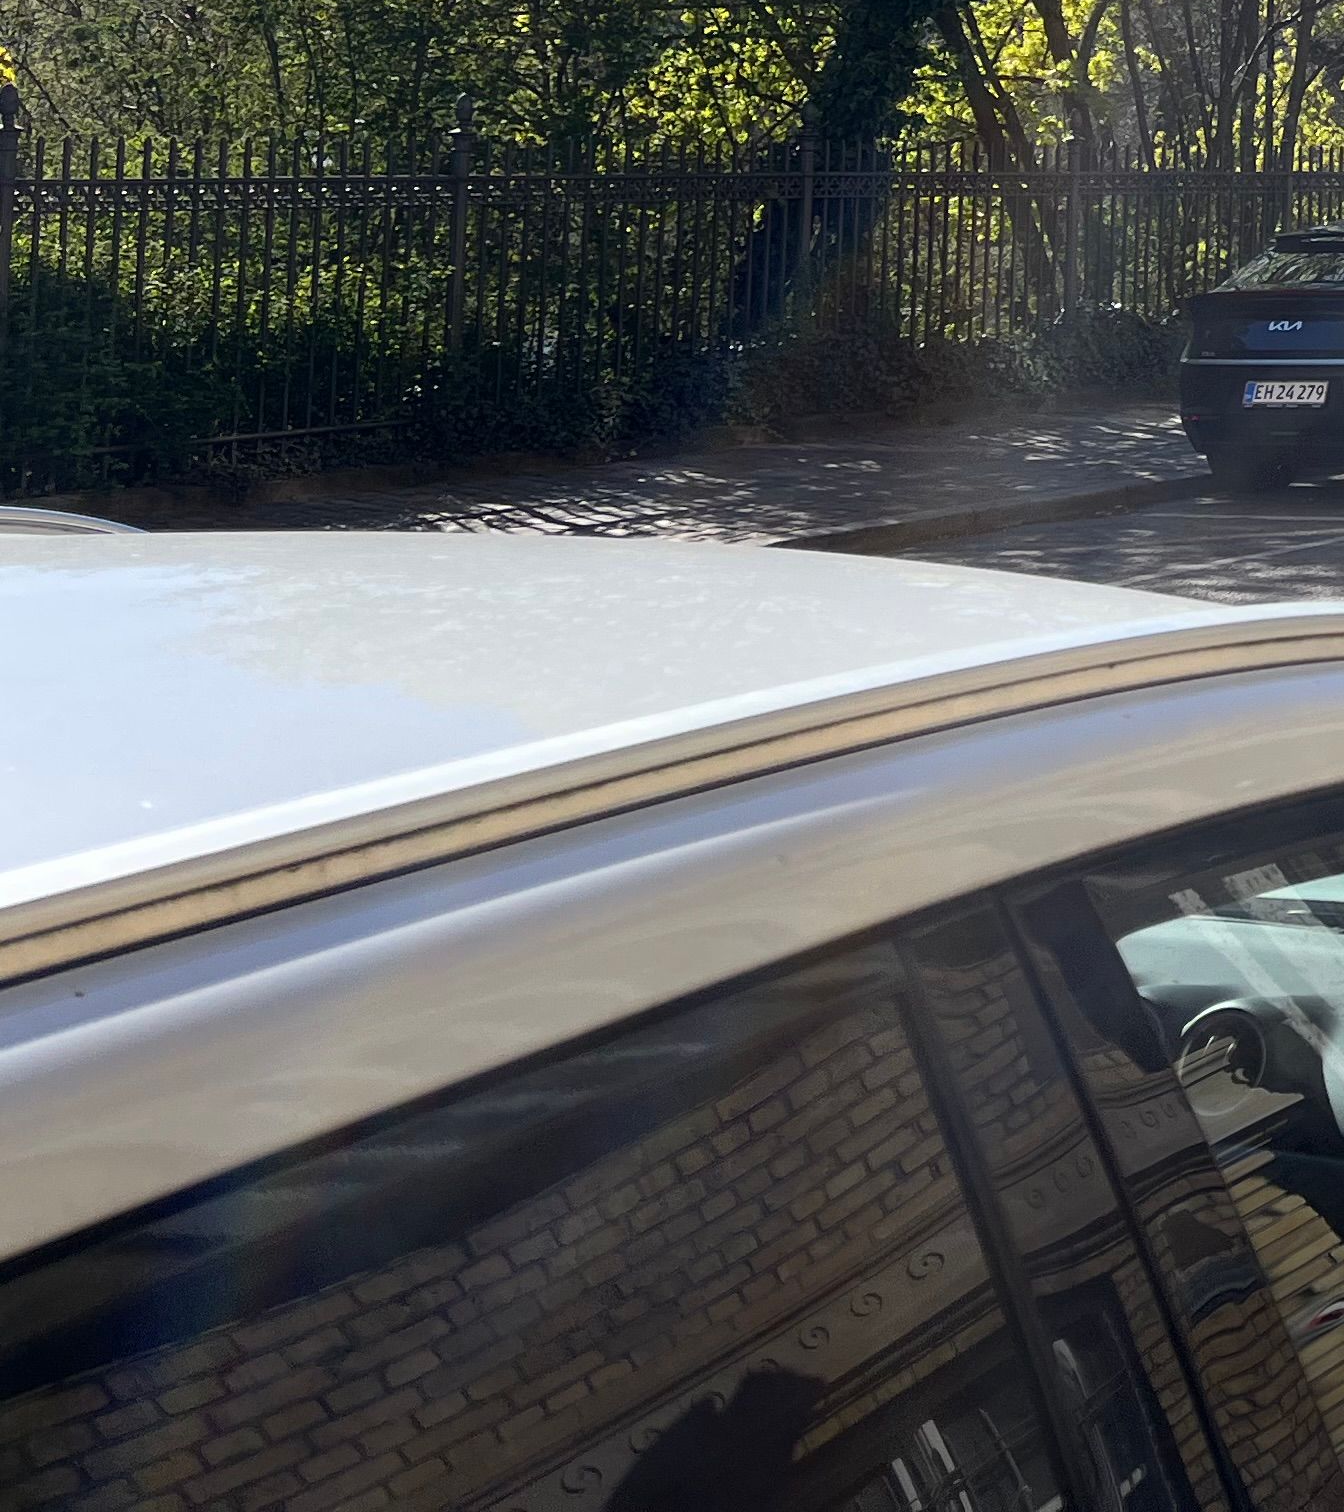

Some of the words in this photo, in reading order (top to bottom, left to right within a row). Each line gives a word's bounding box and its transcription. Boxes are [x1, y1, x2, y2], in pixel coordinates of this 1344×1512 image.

[1254, 384, 1274, 400] EH
[1275, 384, 1295, 400] 24
[1296, 384, 1325, 400] 279
